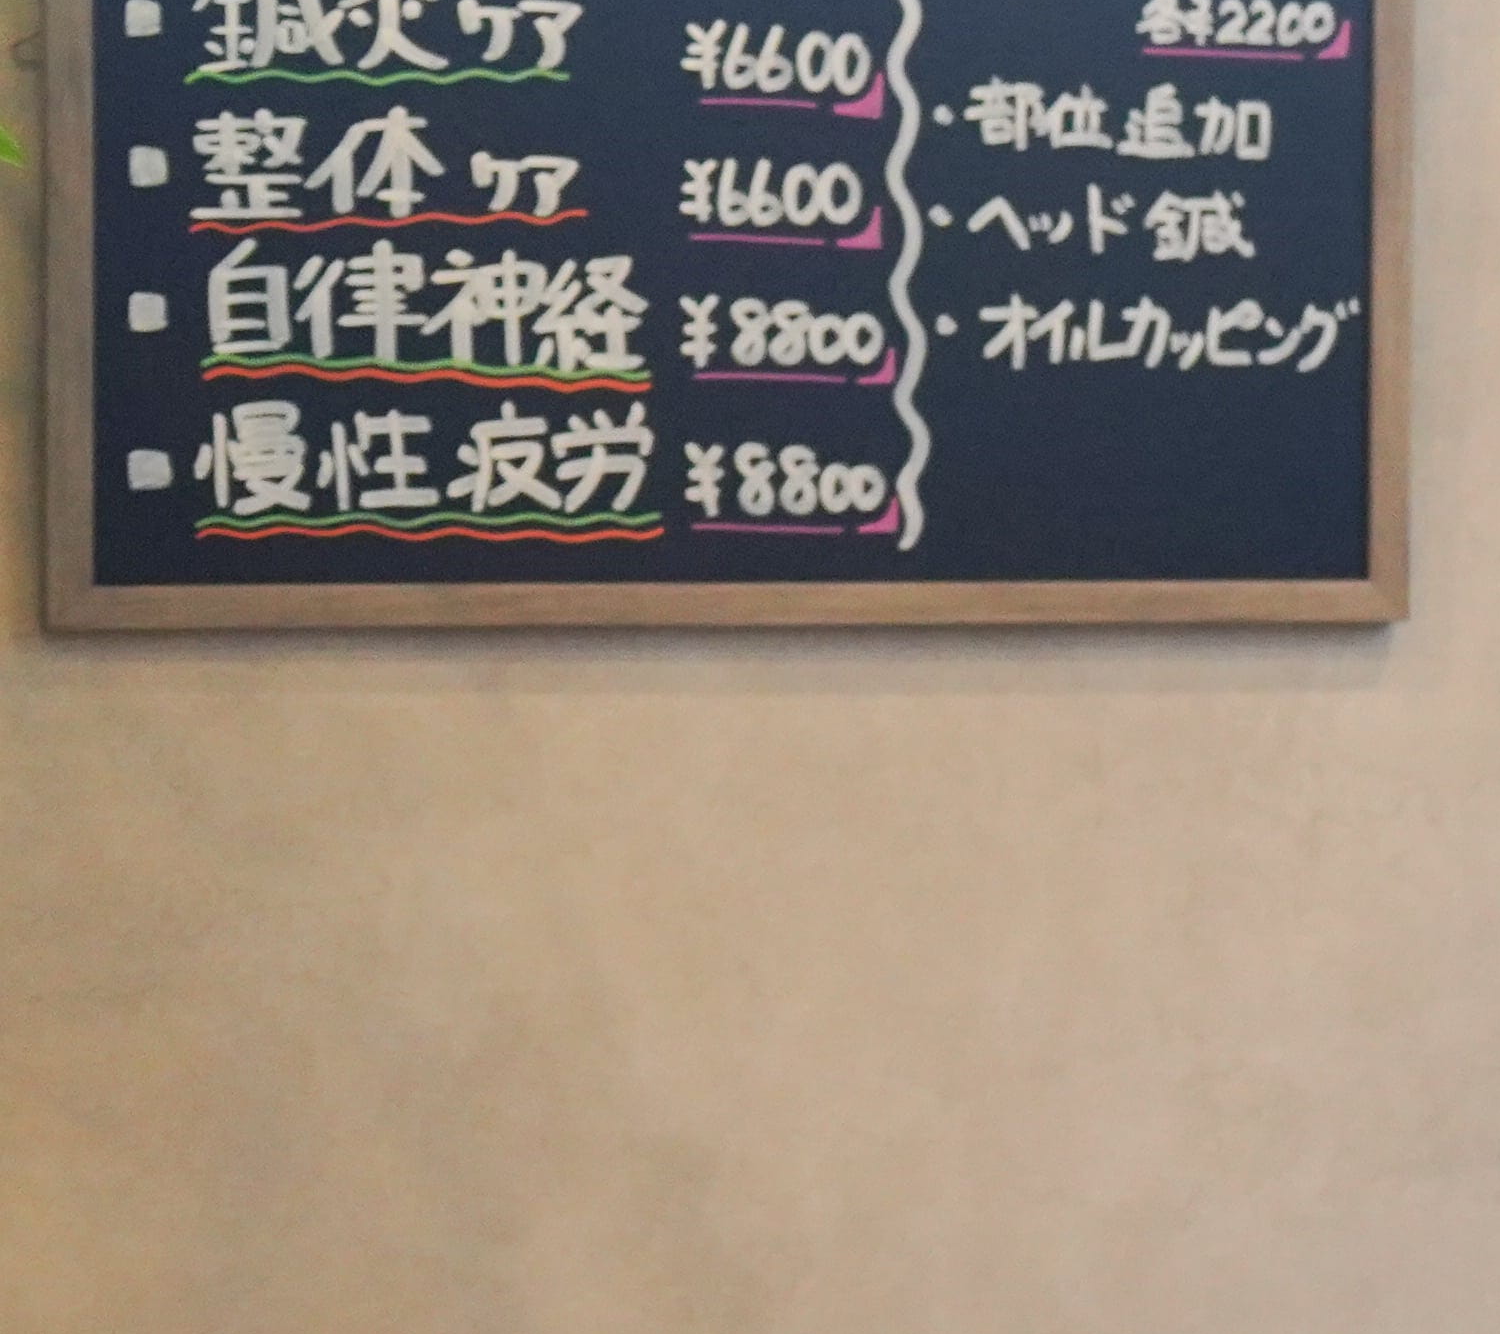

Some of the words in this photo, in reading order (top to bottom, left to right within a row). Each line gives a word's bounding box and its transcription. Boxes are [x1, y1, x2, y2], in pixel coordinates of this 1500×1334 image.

[680, 19, 871, 96] ¥6600
[963, 74, 1272, 161] 部位追加
[679, 157, 863, 227] ¥6600
[207, 238, 649, 373] 自律神経
[679, 293, 884, 368] ¥8800
[979, 292, 1362, 373] オイルカッピング
[193, 400, 655, 516] 慢性疲労
[684, 442, 888, 517] ¥8800
